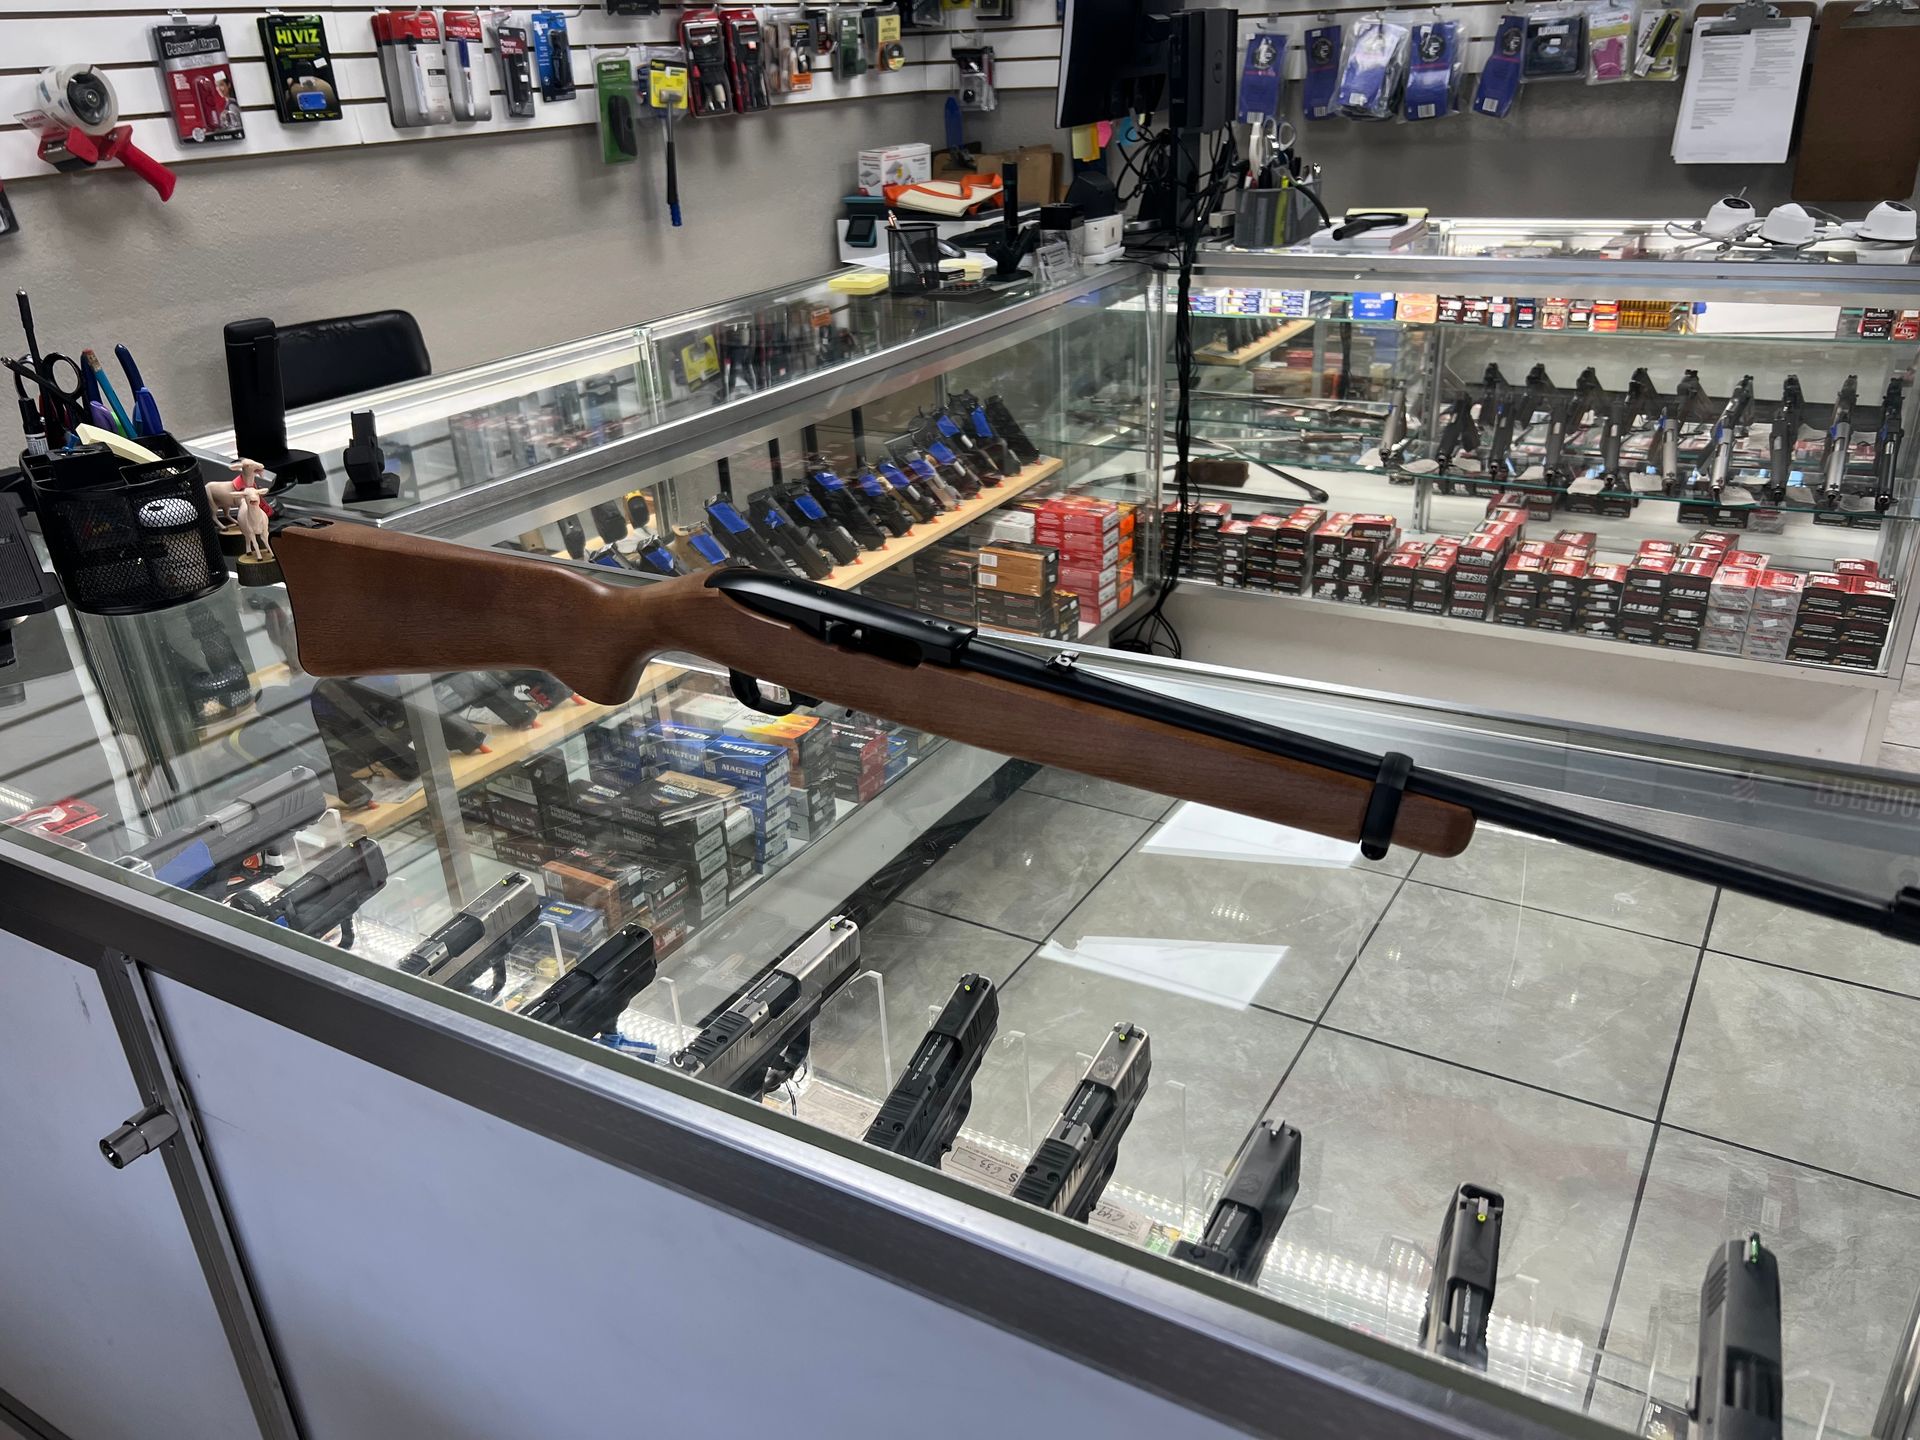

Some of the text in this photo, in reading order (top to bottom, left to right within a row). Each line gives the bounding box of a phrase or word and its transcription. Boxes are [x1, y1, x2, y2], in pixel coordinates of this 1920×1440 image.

[165, 38, 221, 55] Personal Alarm
[661, 726, 710, 740] MAGTECH
[662, 748, 700, 762] MAGTECH
[720, 742, 771, 757] MAGTECH
[721, 764, 762, 778] MAGTECH
[621, 807, 655, 820] FREEDOM
[622, 813, 657, 827] MUNITIONS
